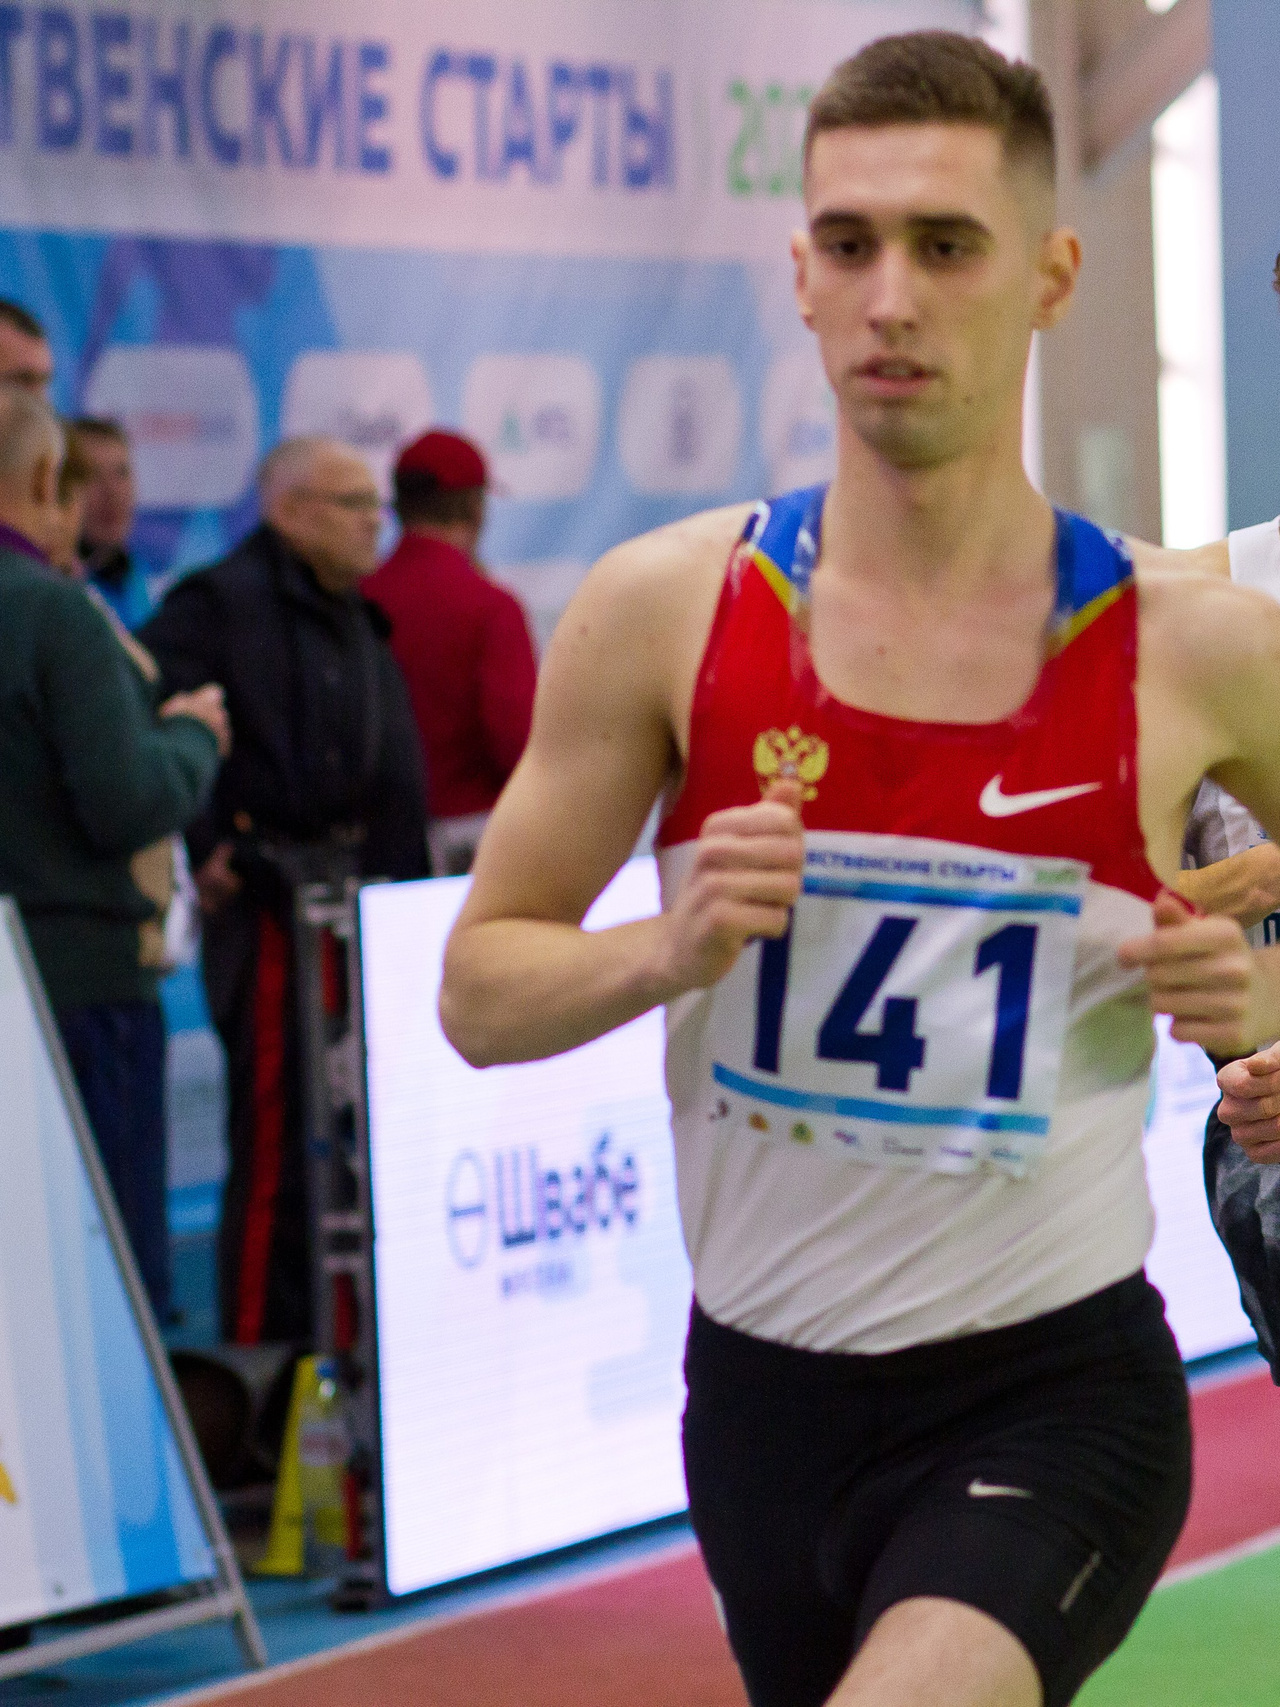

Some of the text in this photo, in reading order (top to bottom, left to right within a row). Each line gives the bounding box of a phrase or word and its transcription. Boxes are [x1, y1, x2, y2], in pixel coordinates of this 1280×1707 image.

[420, 46, 676, 190] СТАРТЫ
[744, 904, 1040, 1101] 141
[495, 1129, 639, 1249] Швабе
